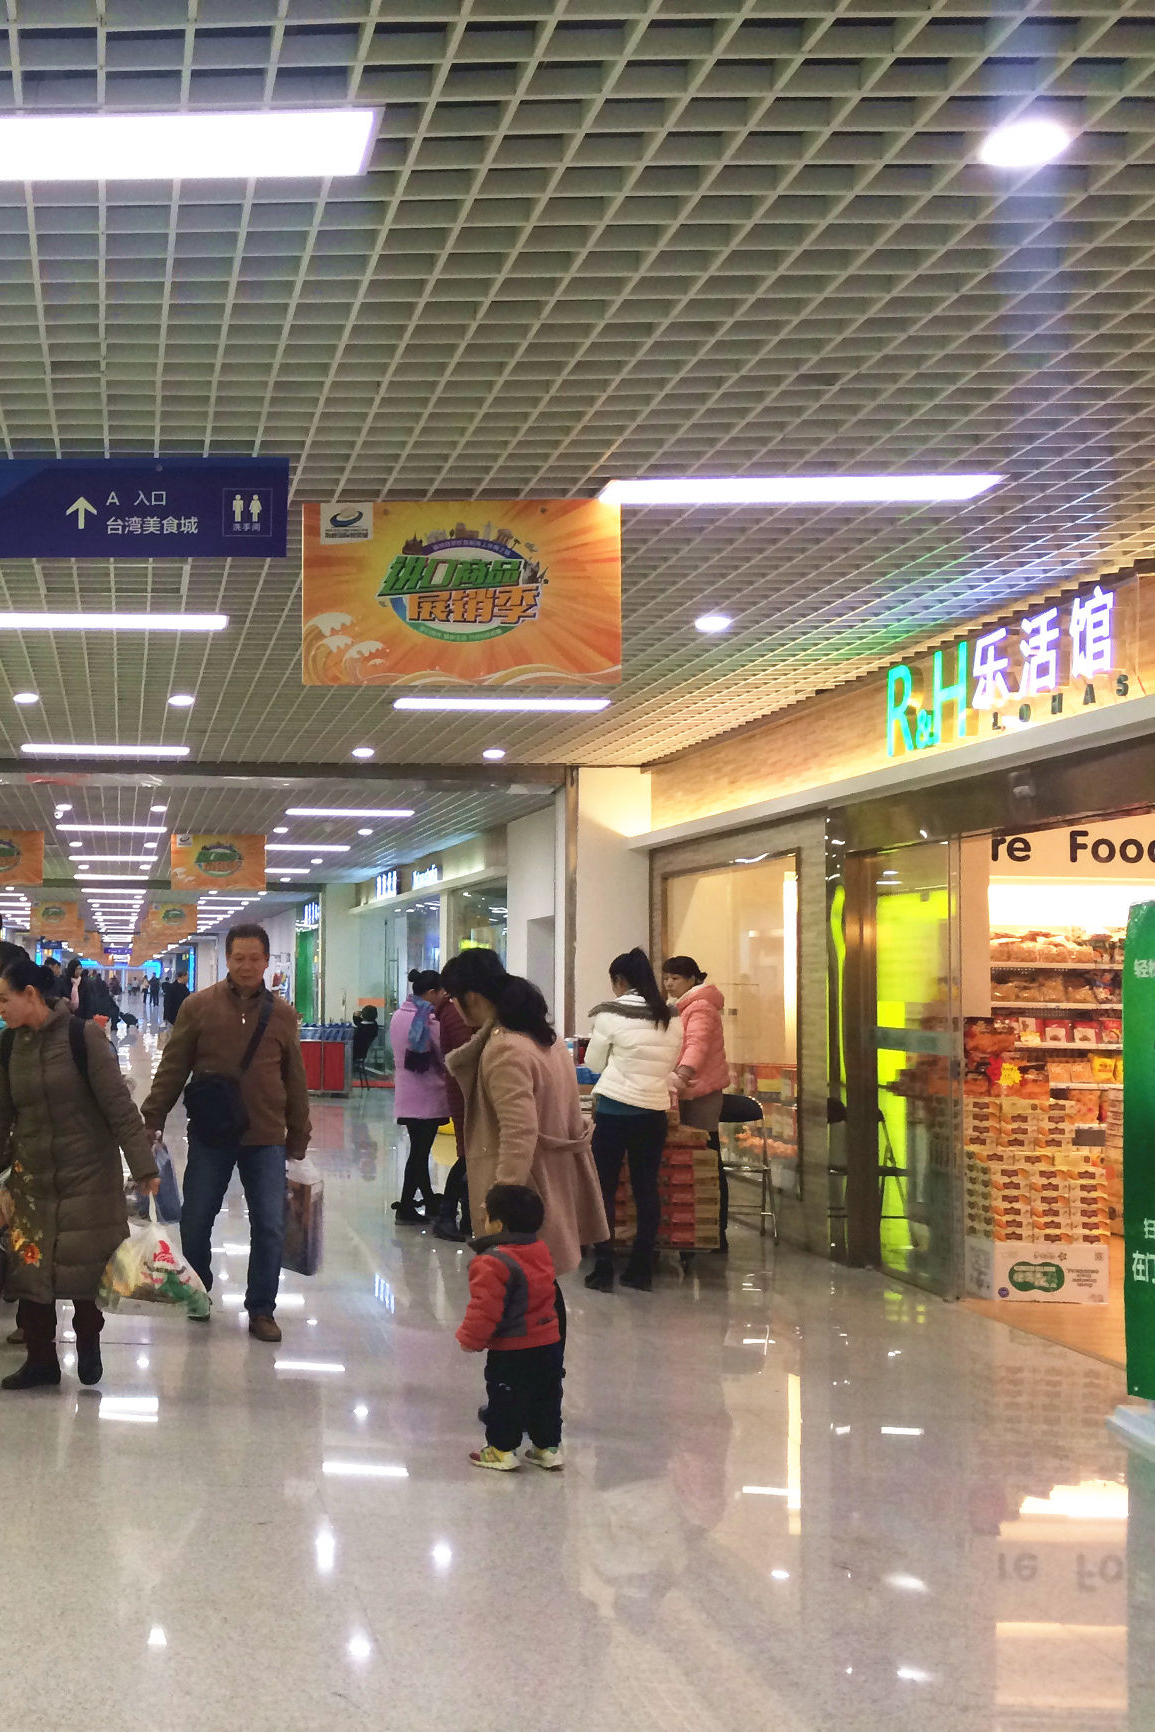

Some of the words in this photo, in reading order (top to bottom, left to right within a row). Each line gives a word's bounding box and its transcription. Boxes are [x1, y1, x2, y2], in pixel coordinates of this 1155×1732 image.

[106, 491, 120, 506] A
[133, 490, 167, 506] 入口
[106, 515, 199, 535] 台湾美食城
[377, 555, 521, 597] 进口商品
[407, 585, 540, 625] 展销季
[886, 641, 968, 757] R&H
[972, 585, 1115, 709] 乐活馆
[992, 674, 1130, 731] LOHAS
